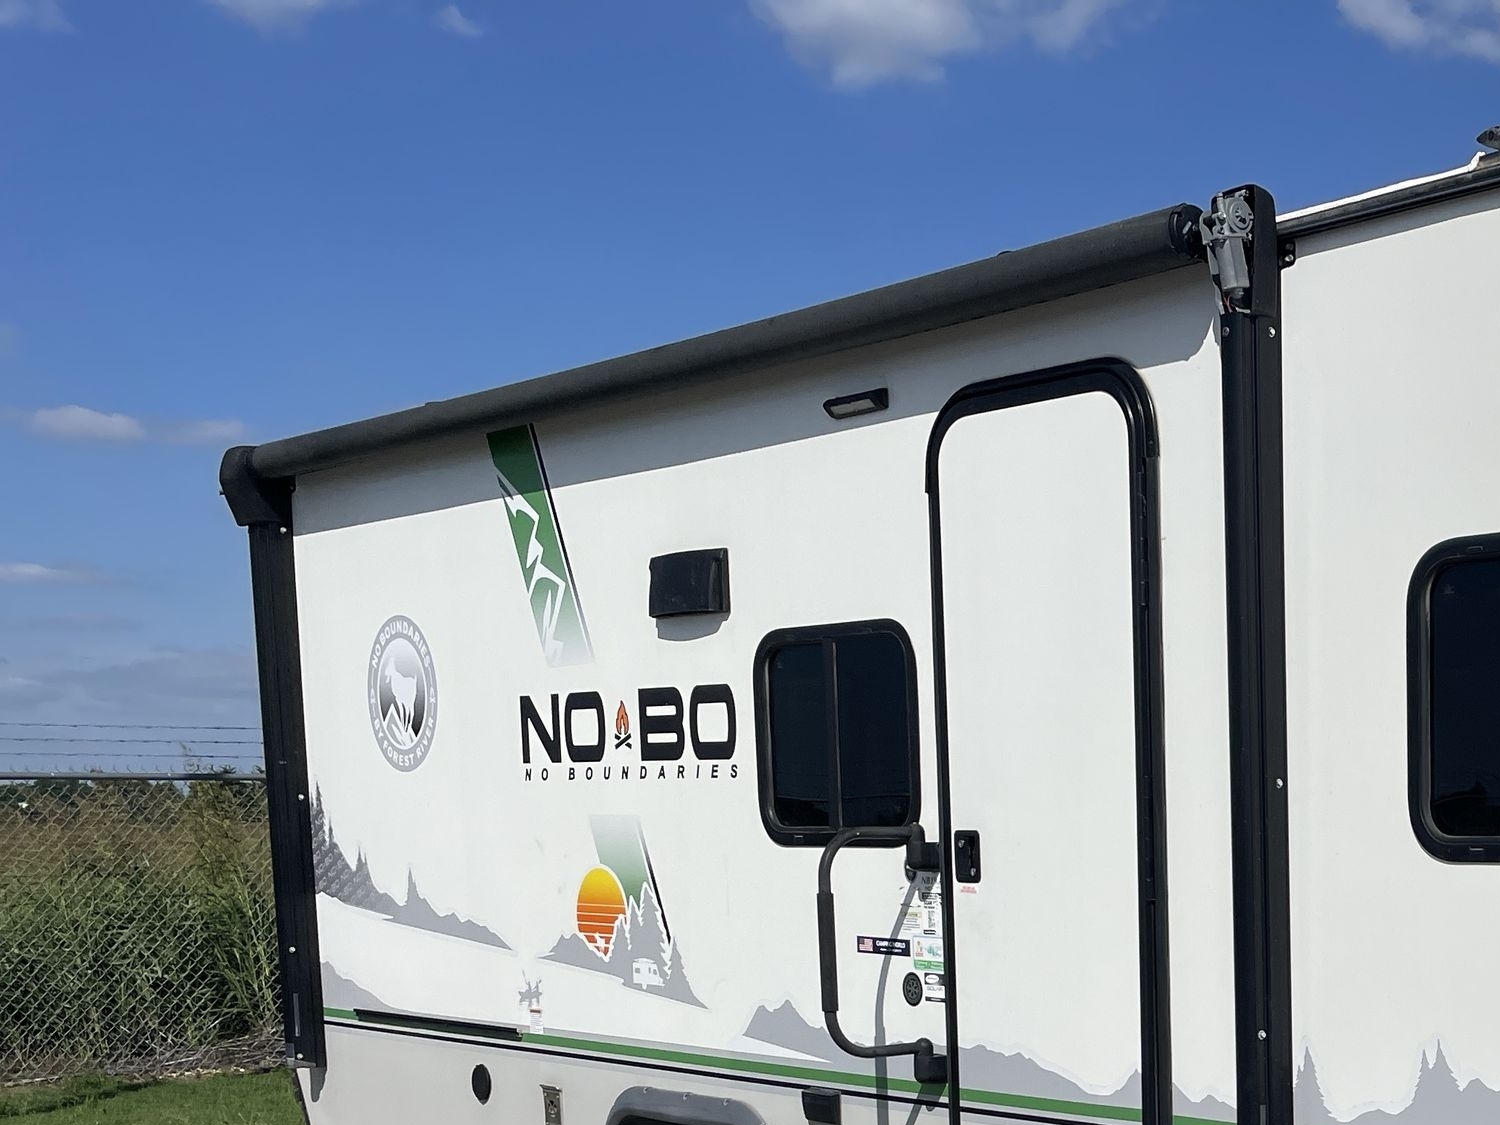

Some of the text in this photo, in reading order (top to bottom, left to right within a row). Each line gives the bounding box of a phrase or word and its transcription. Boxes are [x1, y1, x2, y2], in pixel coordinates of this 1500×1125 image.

[372, 620, 431, 668] NO BOUNDARIES
[373, 717, 434, 767] BY FOREST RIVER
[524, 764, 738, 781] NO BOUNDARIES
